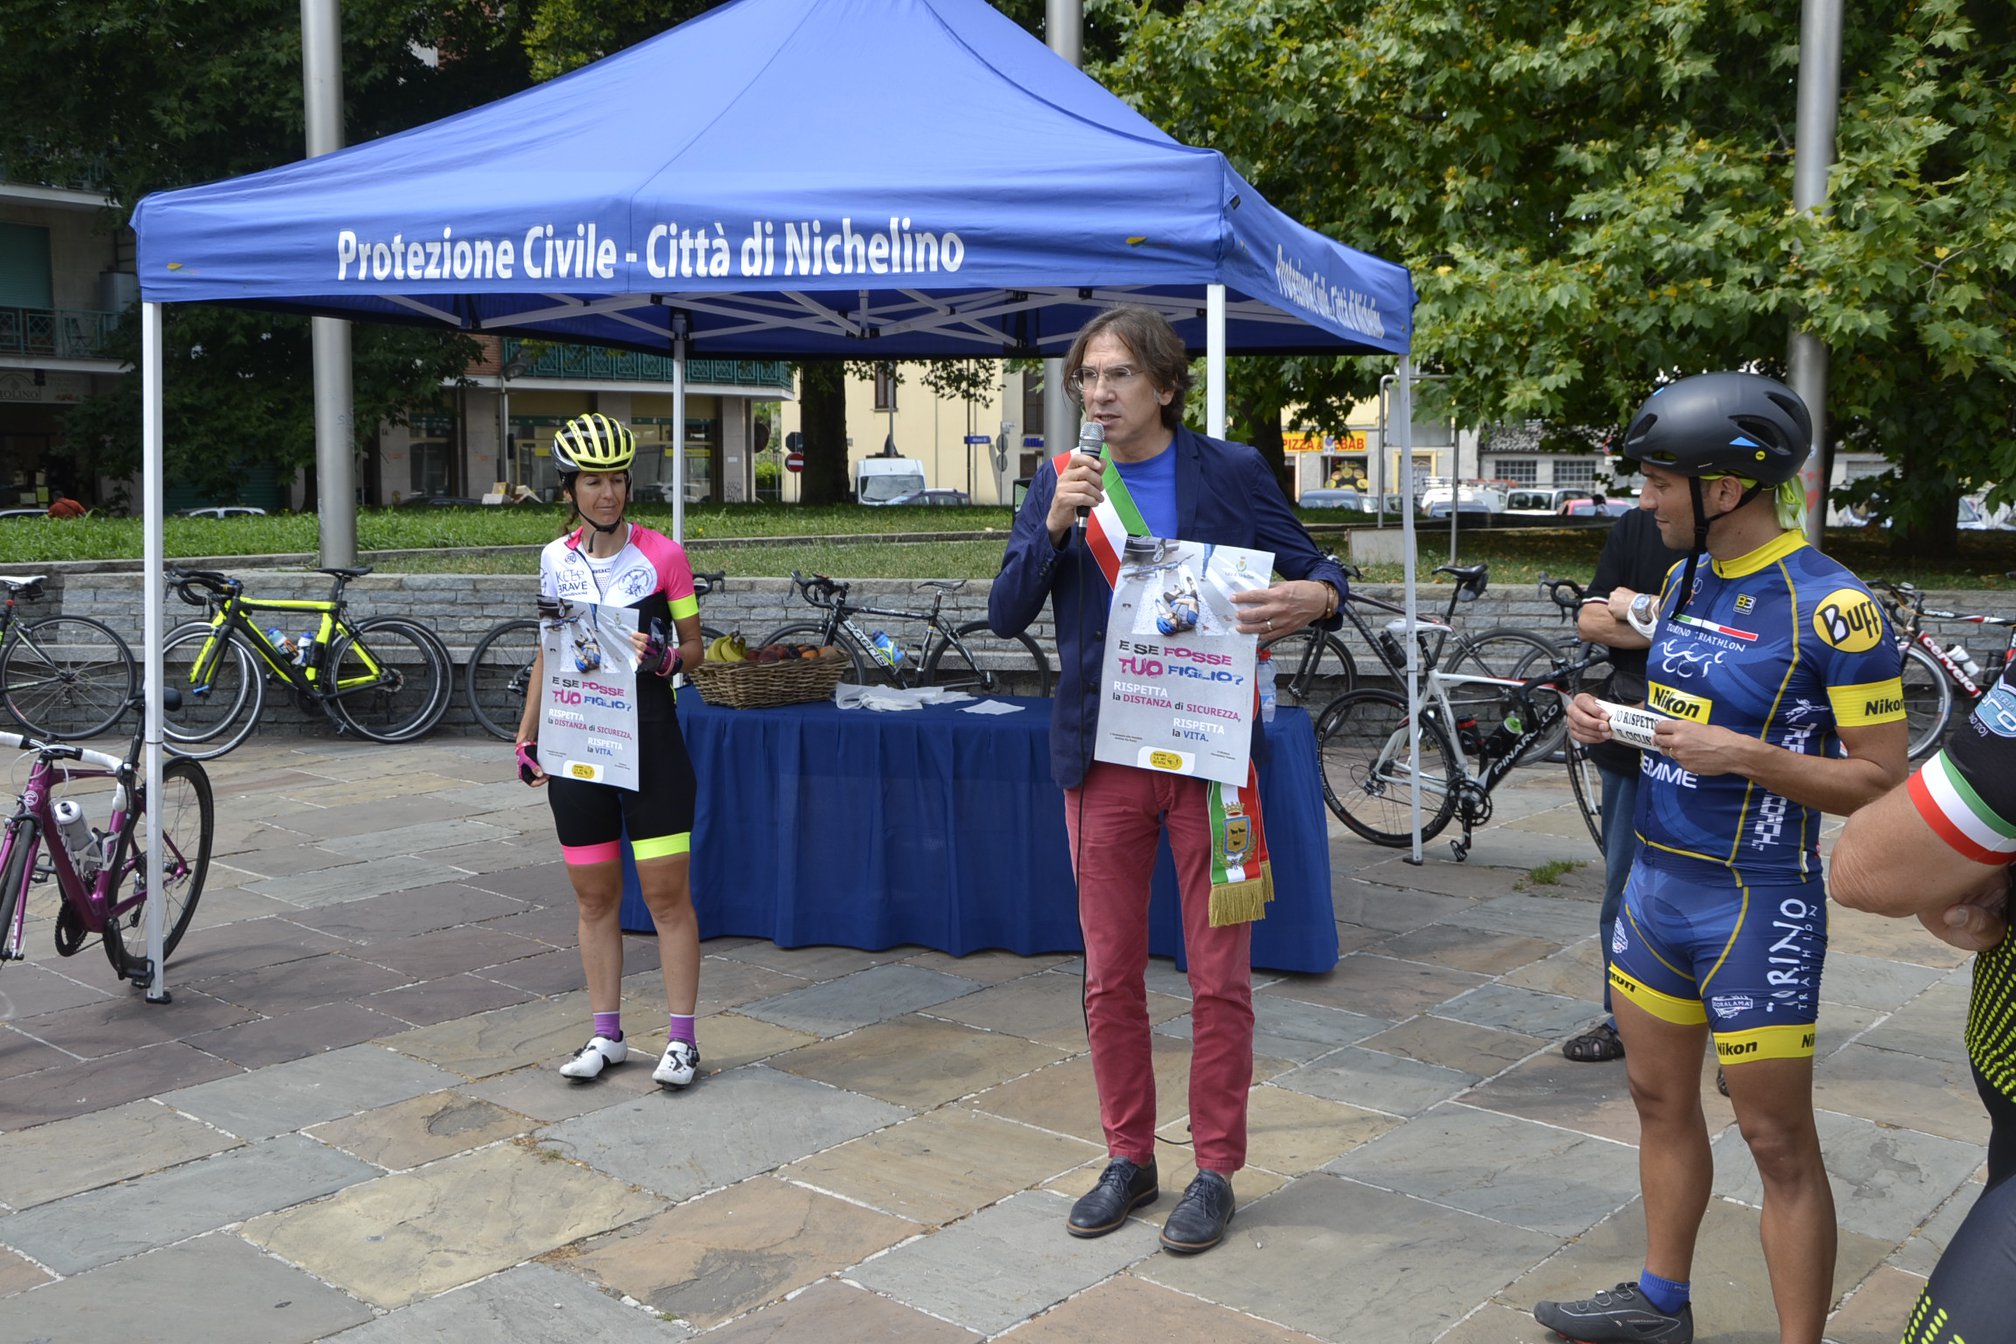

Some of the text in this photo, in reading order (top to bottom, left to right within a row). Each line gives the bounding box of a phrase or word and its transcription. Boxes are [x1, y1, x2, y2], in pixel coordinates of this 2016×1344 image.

[337, 227, 514, 281] Protezione
[523, 222, 617, 280] Civile
[646, 220, 731, 279] Città
[741, 222, 774, 277] di
[785, 216, 965, 277] Nichelino
[1283, 438, 1315, 451] PIZZA
[1815, 600, 1880, 647] Buff
[1119, 640, 1232, 667] E SE FOSSE
[1118, 656, 1244, 686] TUO FIGLIO?
[552, 676, 625, 698] E SE FOSSE
[1113, 680, 1169, 698] RISPETTA
[552, 688, 632, 712] TUO FIGLIO?
[1112, 692, 1242, 723] la DISTANZA di SICUREZZA,
[1652, 686, 1701, 719] Nikon
[548, 708, 585, 722] RISPETTA
[548, 717, 633, 741] la DISTANZA di SICUREZZA,
[1172, 729, 1209, 742] la VITA.
[1173, 717, 1225, 735] RISPETTA
[587, 736, 623, 751] RISPETTA
[1626, 730, 1653, 746] CICLIS
[595, 747, 613, 757] VITA.
[1717, 1041, 1758, 1057] Nikon
